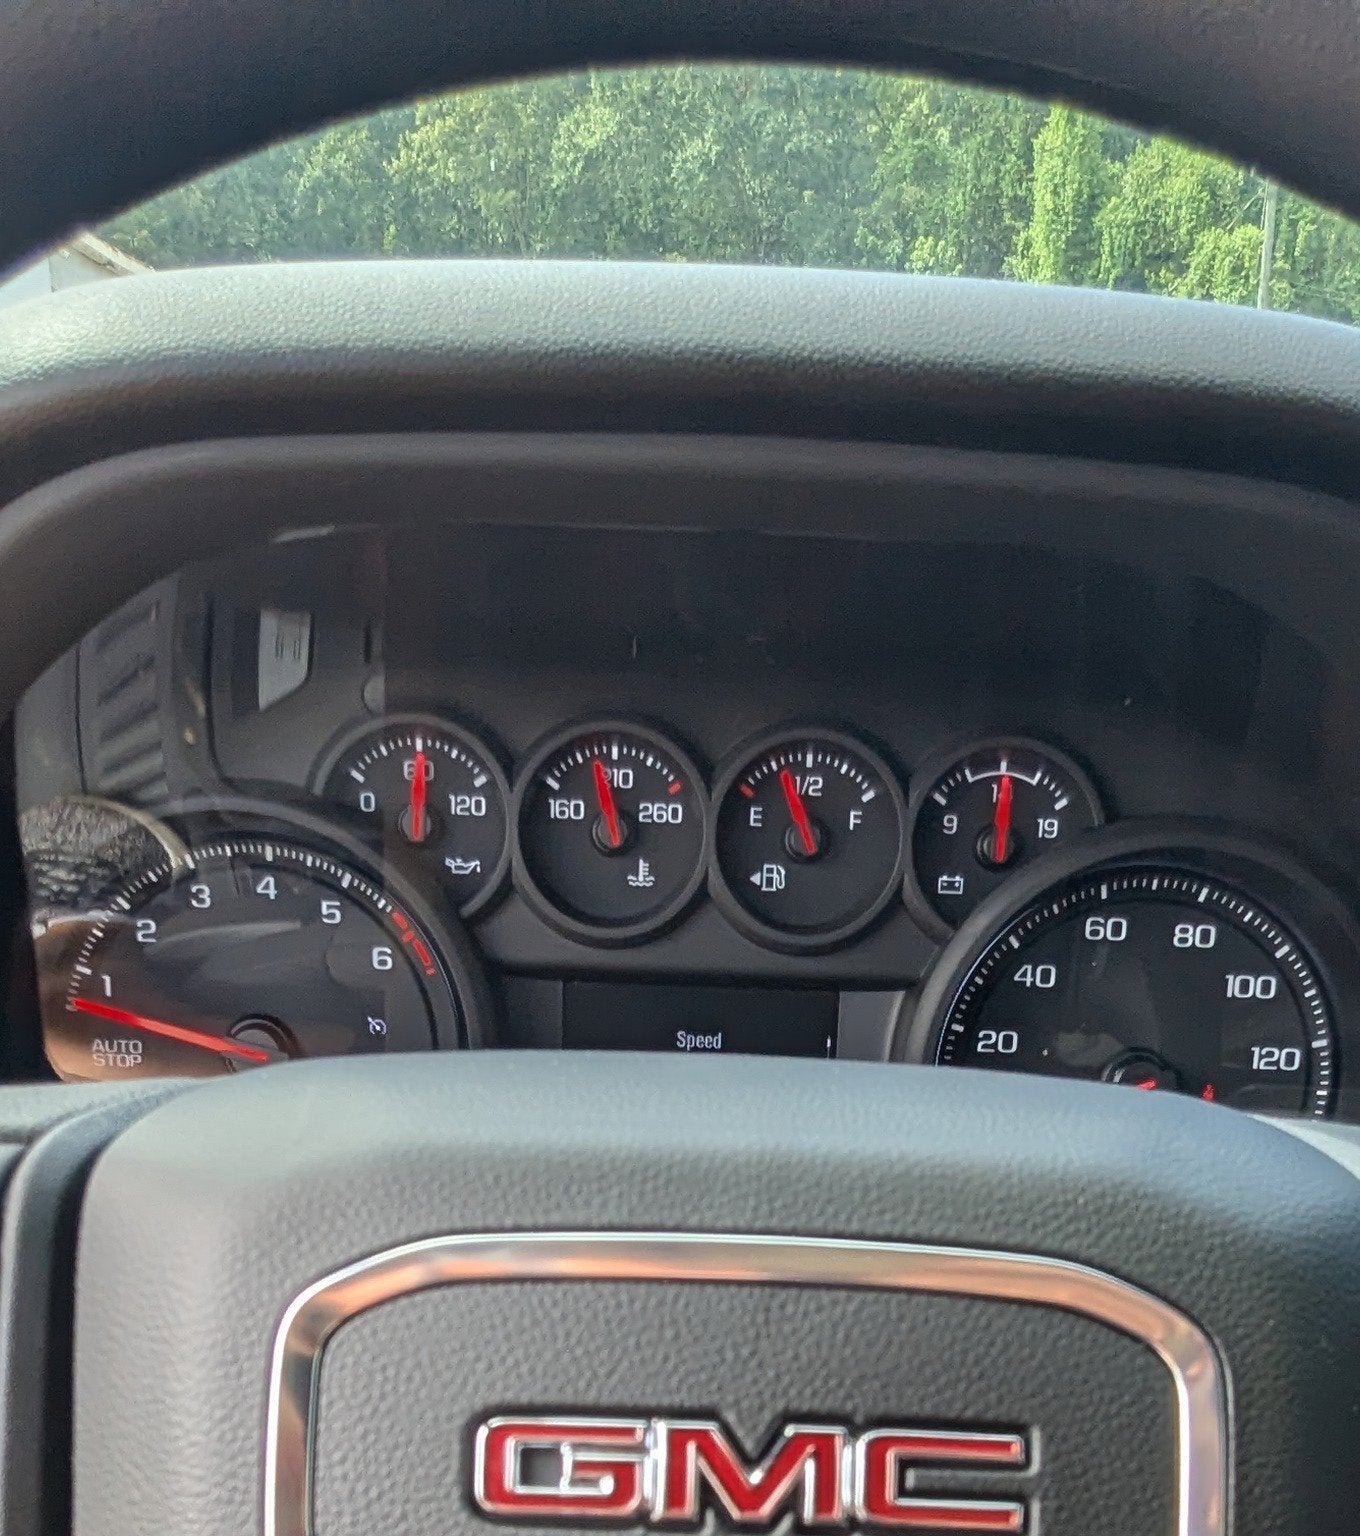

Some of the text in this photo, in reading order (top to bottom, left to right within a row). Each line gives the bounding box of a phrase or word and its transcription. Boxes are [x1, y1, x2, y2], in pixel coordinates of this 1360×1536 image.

[795, 776, 823, 797] 1/2
[360, 792, 376, 813] 0
[448, 794, 487, 817] 120
[549, 798, 585, 820] 160
[638, 803, 683, 824] 260
[749, 806, 763, 827] E
[849, 810, 863, 831] F
[942, 814, 958, 835] 9
[1037, 818, 1059, 839] 19
[191, 884, 211, 908] 3
[256, 876, 278, 900] 4
[320, 900, 342, 924] 5
[136, 918, 157, 943] 2
[1084, 916, 1128, 941] 60
[1172, 924, 1217, 949] 80
[371, 946, 393, 970] 6
[101, 974, 112, 998] 1
[1013, 964, 1057, 988] 40
[1224, 974, 1277, 1000] 100
[91, 1038, 143, 1054] AUTO
[675, 1030, 723, 1051] Speed
[976, 1030, 1019, 1054] 20
[92, 1054, 143, 1068] STOP
[1250, 1046, 1301, 1071] 120
[473, 1416, 1025, 1533] GMC
